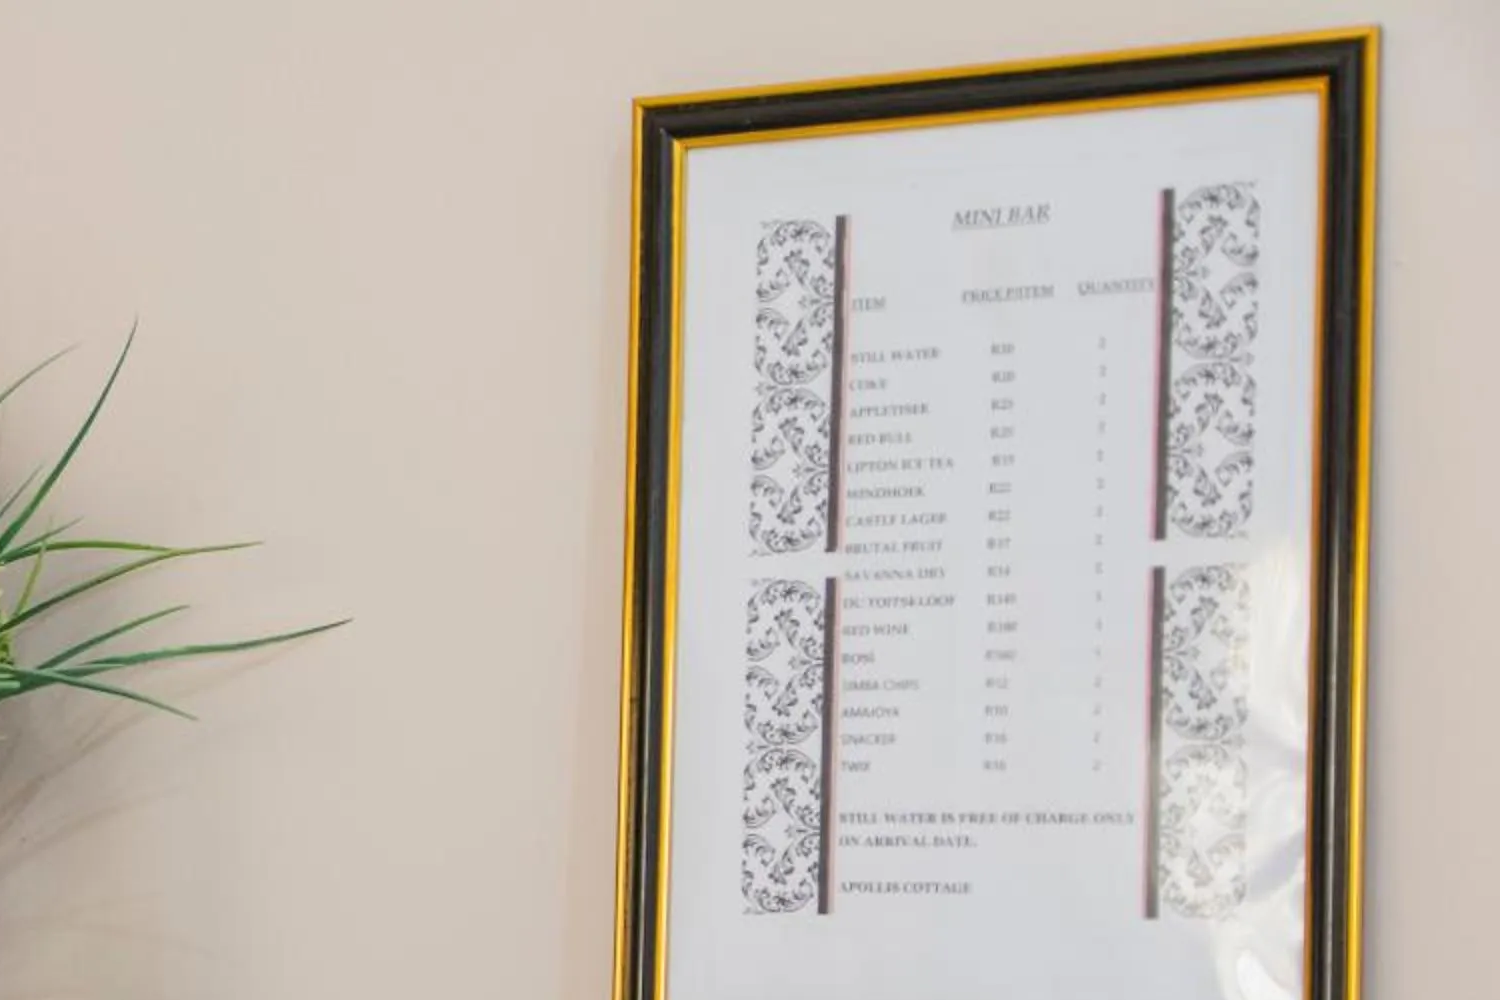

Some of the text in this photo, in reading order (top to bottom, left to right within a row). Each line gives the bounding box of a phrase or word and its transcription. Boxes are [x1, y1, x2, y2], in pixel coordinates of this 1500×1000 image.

[951, 203, 1051, 230] MINI BAR
[1077, 277, 1155, 297] QUANTITY
[851, 296, 887, 312] ITEM
[847, 433, 875, 446] RED
[847, 459, 898, 474] LIPTON
[929, 456, 956, 469] TEA
[845, 512, 948, 528] CASTLE LAGER
[844, 542, 900, 555] BRUTAL
[838, 811, 1135, 825] STILL WATER IS FREE OF CHARGE ONLY
[838, 835, 863, 848] ON
[865, 834, 928, 848] ARRIVAL
[902, 880, 972, 894] COTTAGE
